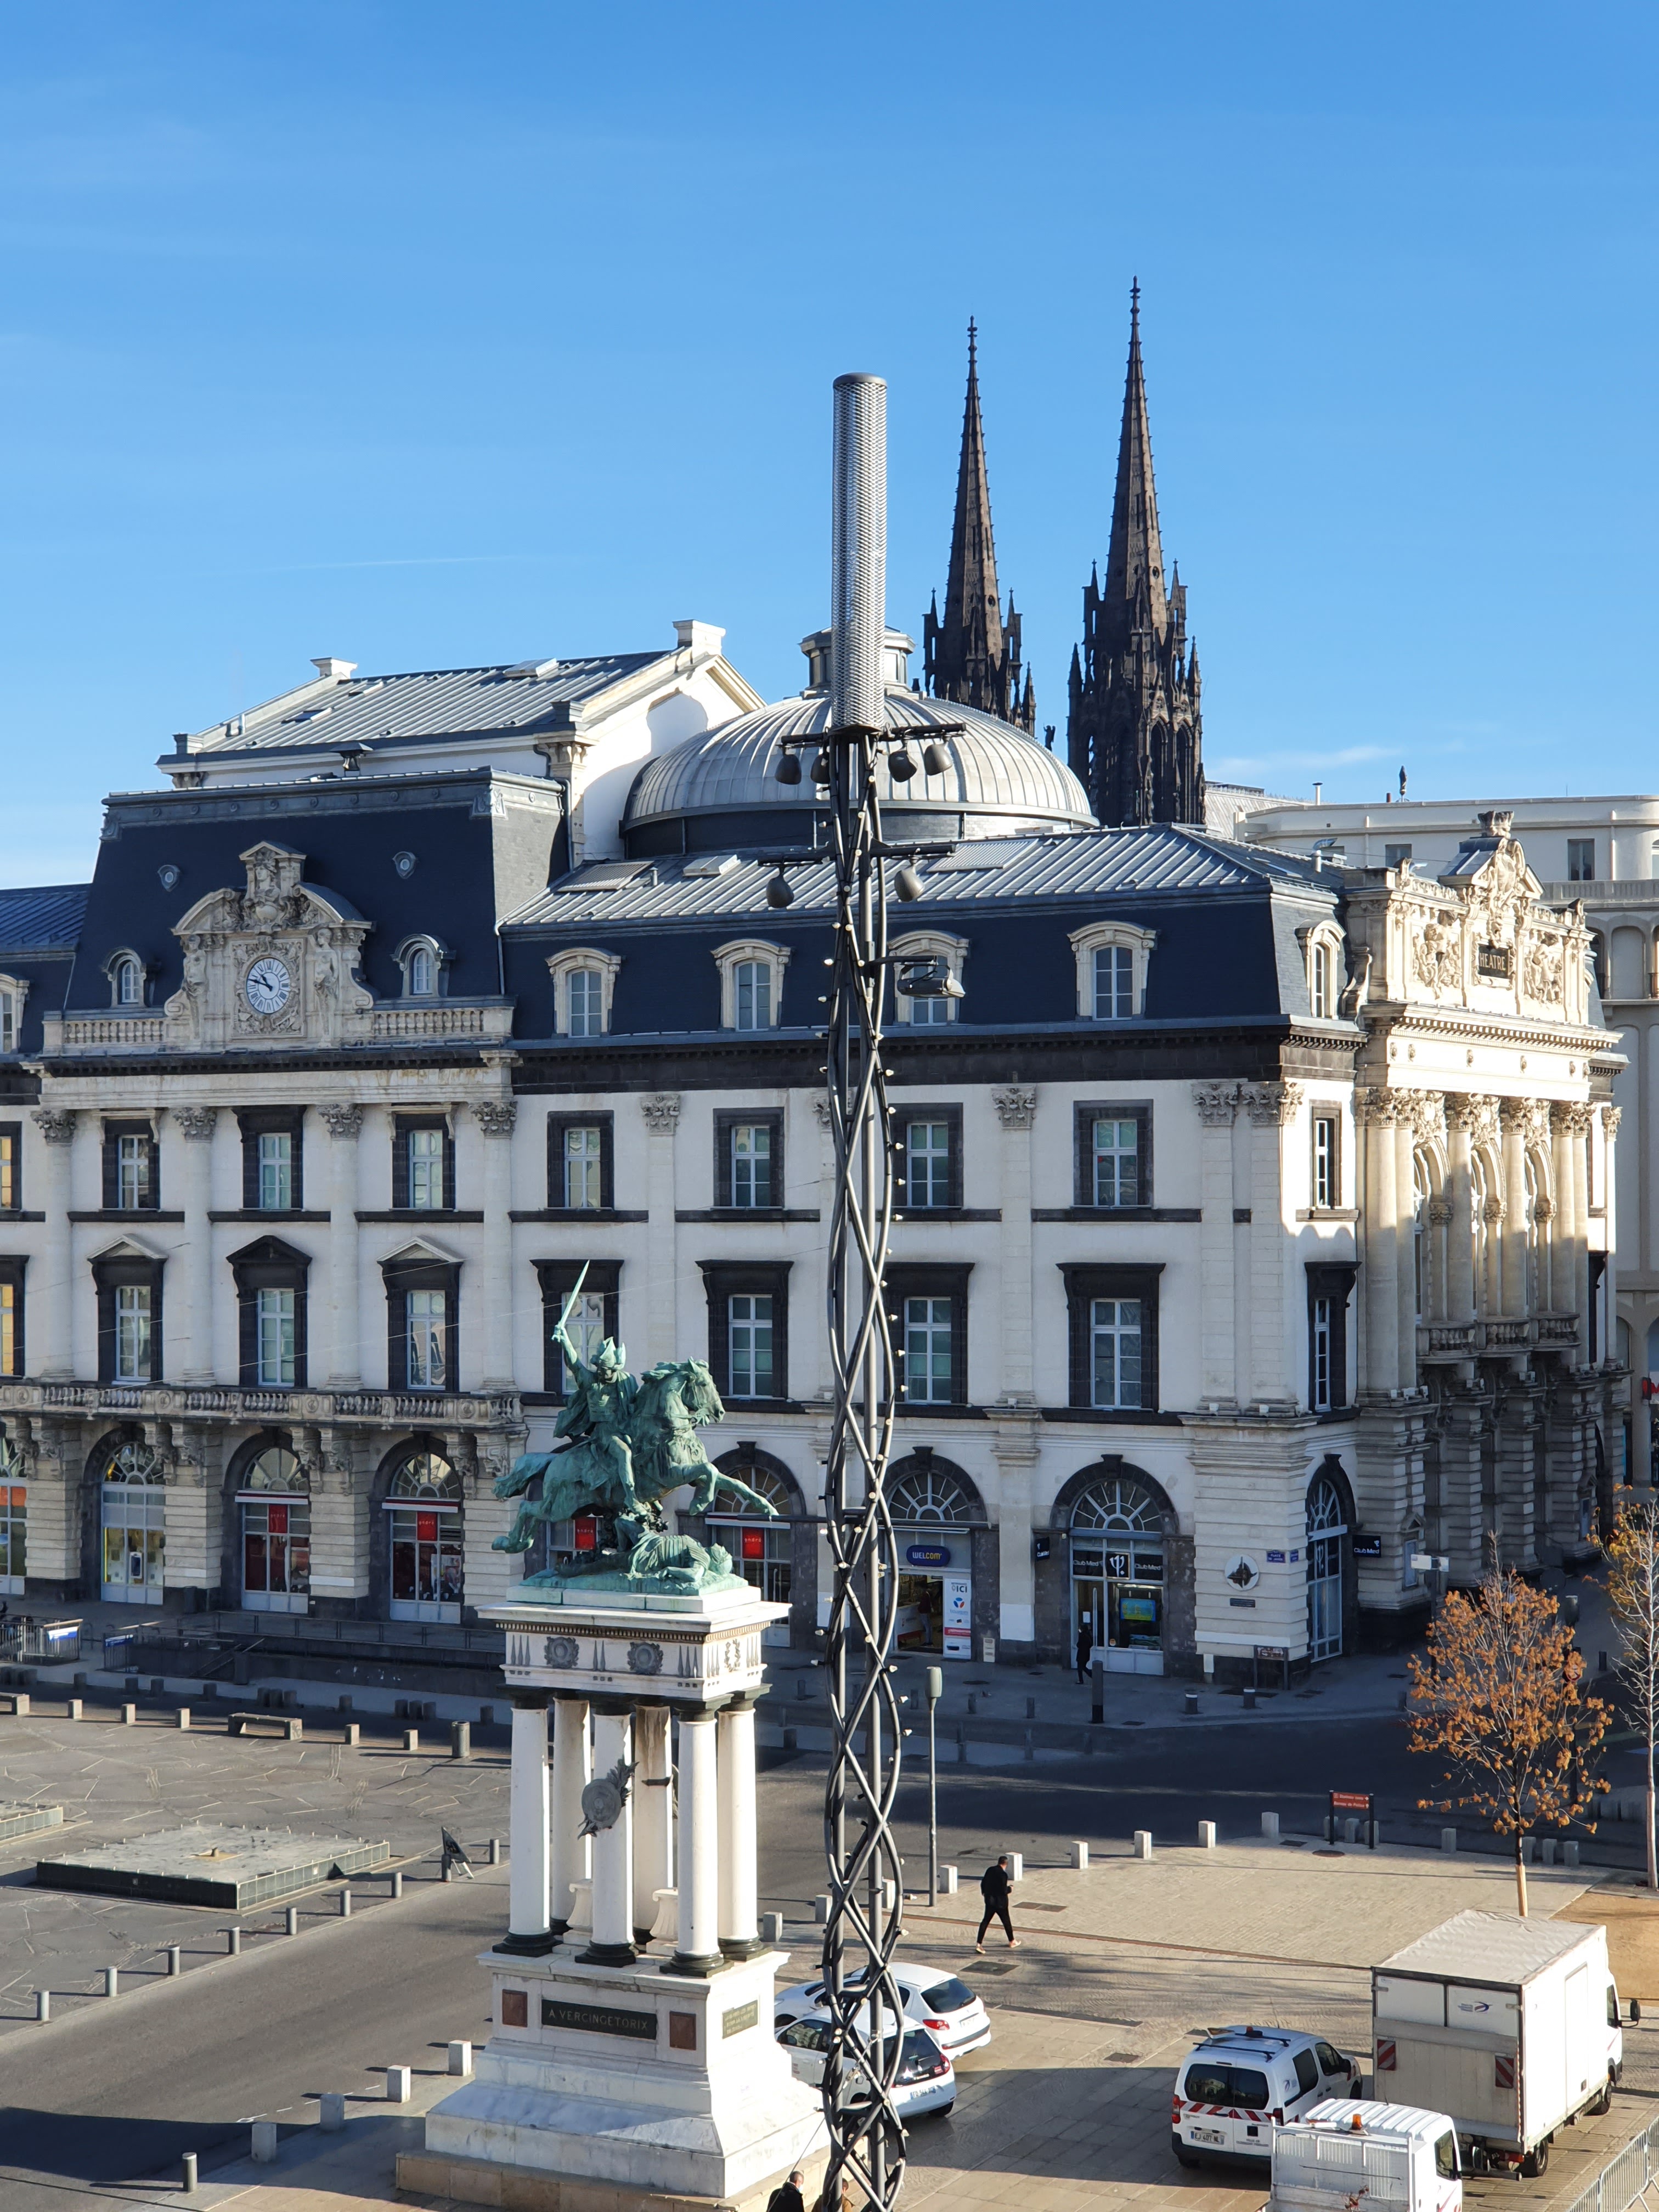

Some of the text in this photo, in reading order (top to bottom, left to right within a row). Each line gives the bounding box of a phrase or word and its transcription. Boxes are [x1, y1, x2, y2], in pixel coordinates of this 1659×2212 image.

[1480, 952, 1506, 971] HEATRE
[549, 2008, 647, 2030] A VERCINGETORIX
